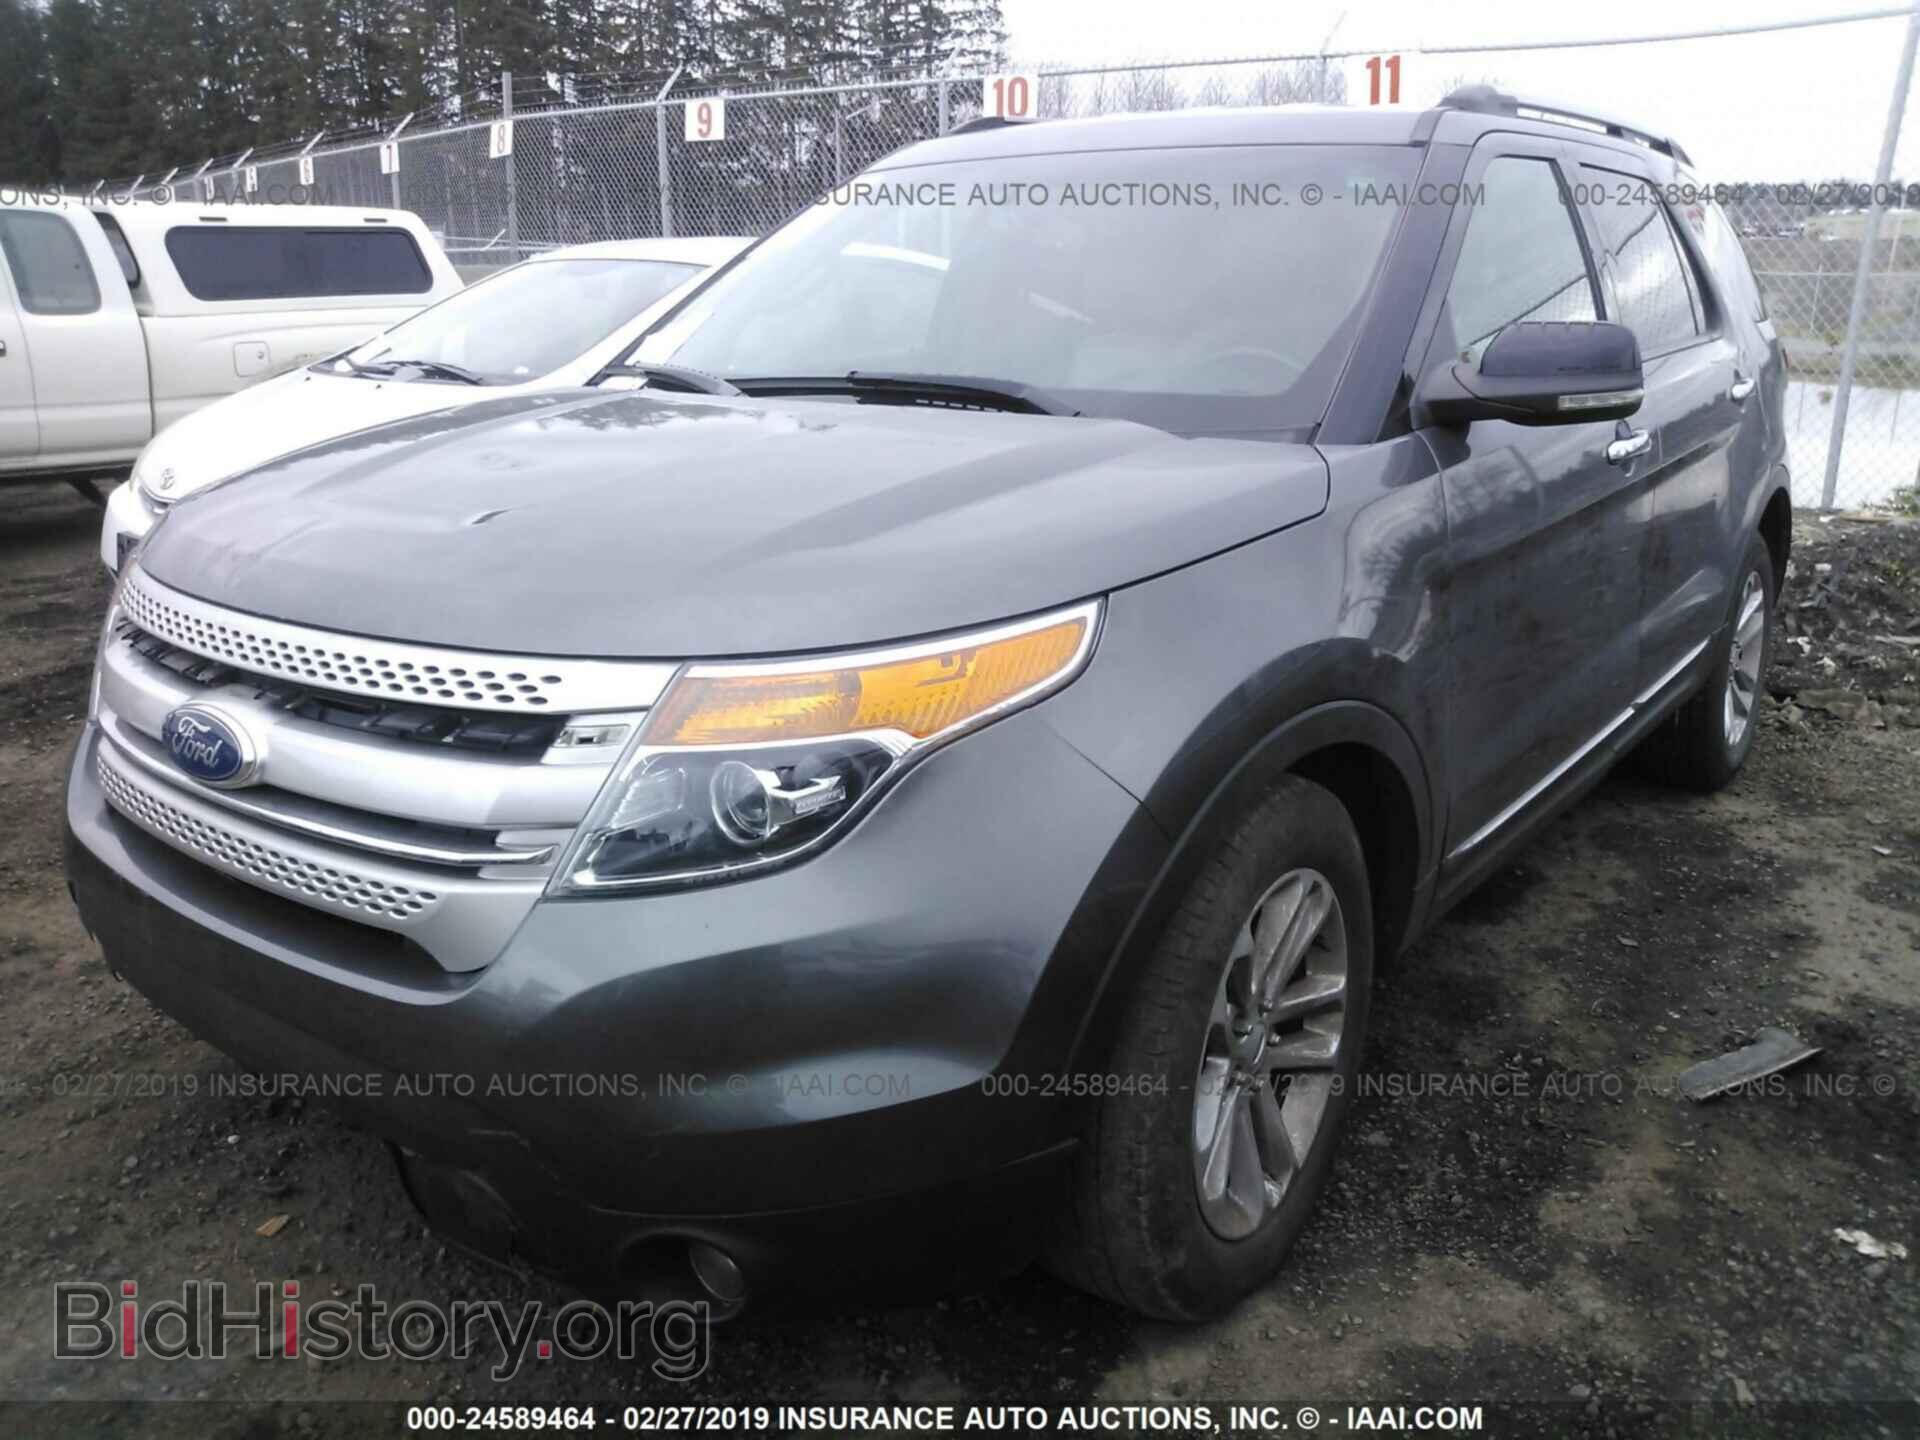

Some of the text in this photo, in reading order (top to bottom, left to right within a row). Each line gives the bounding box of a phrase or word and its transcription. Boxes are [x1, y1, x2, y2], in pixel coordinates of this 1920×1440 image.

[992, 77, 1028, 118] 10
[1366, 55, 1401, 105] 11
[697, 102, 712, 138] 9
[172, 716, 224, 769] Ford
